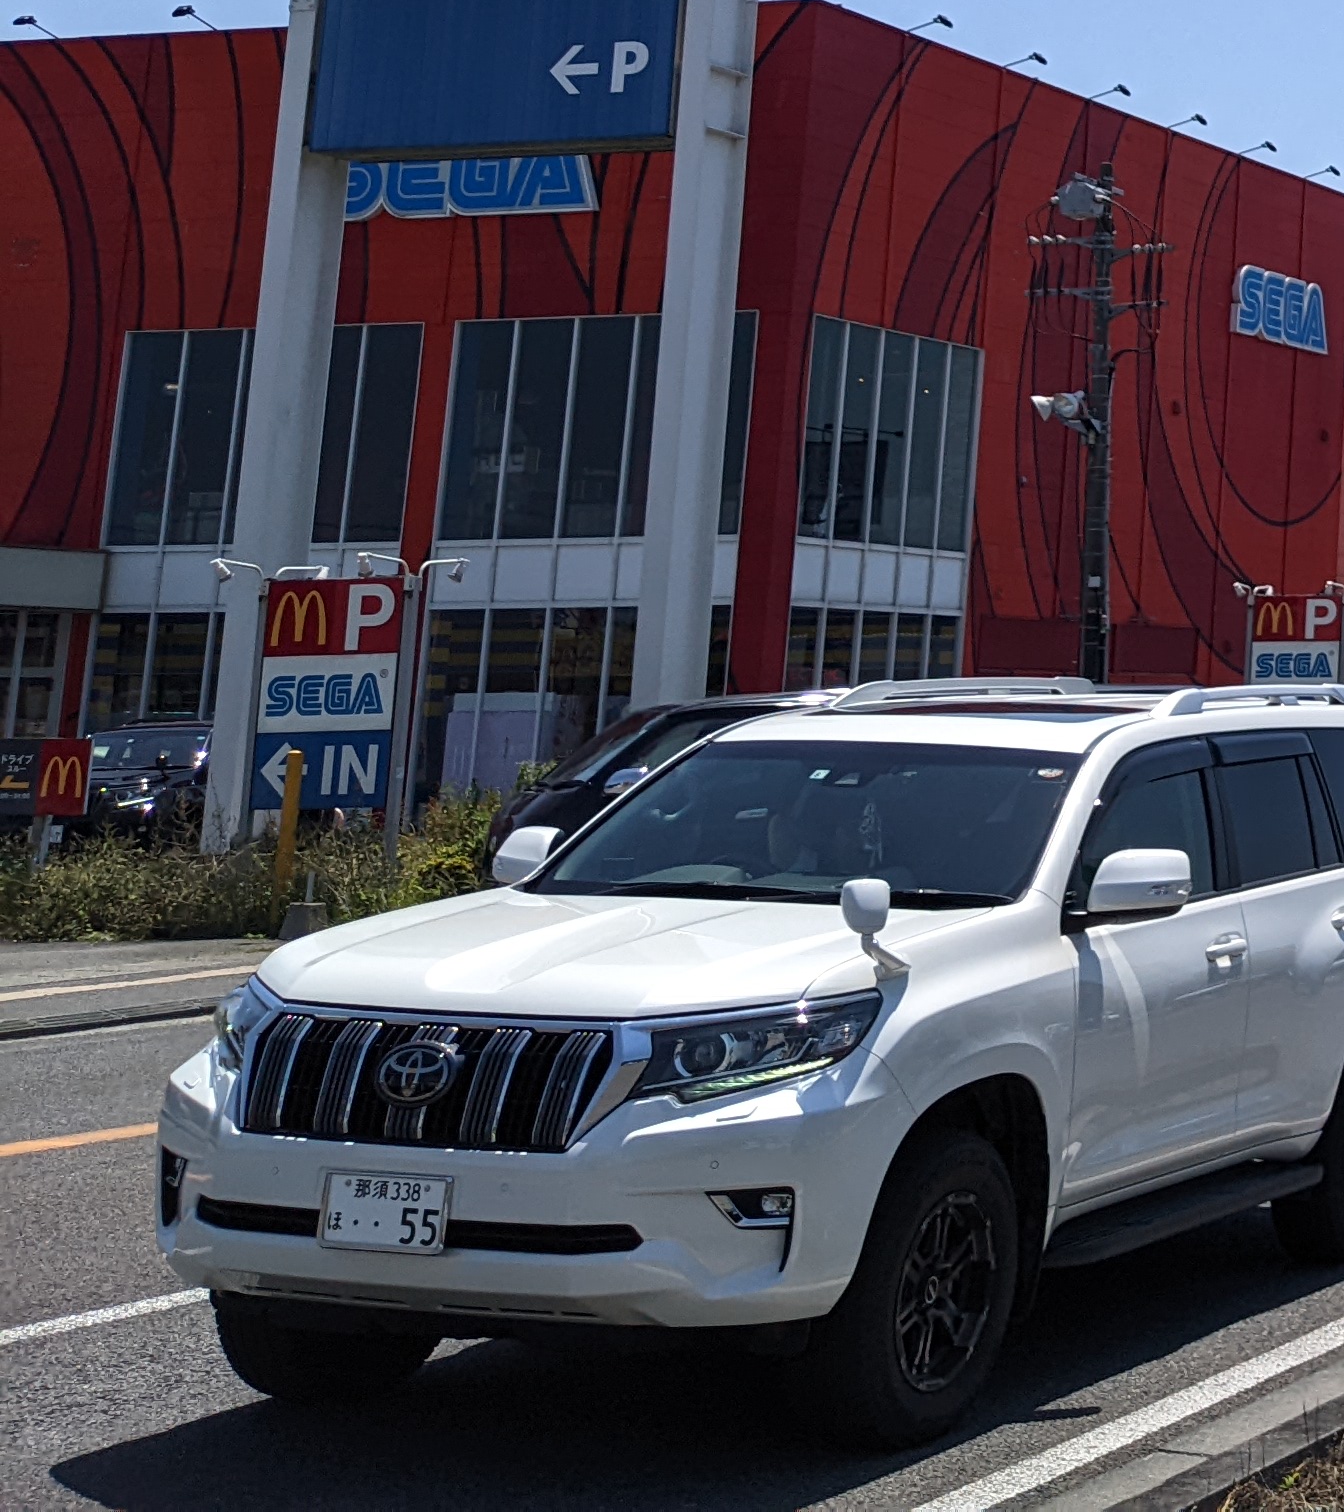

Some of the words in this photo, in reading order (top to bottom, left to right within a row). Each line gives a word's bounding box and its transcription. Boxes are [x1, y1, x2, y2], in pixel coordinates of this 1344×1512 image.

[610, 41, 650, 93] P
[1237, 265, 1328, 355] SEGA
[344, 583, 396, 651] P
[1304, 598, 1337, 640] P
[1255, 652, 1333, 678] SEGA
[265, 672, 384, 717] SEGA
[1, 753, 35, 765] ドライブ
[320, 744, 379, 795] IN
